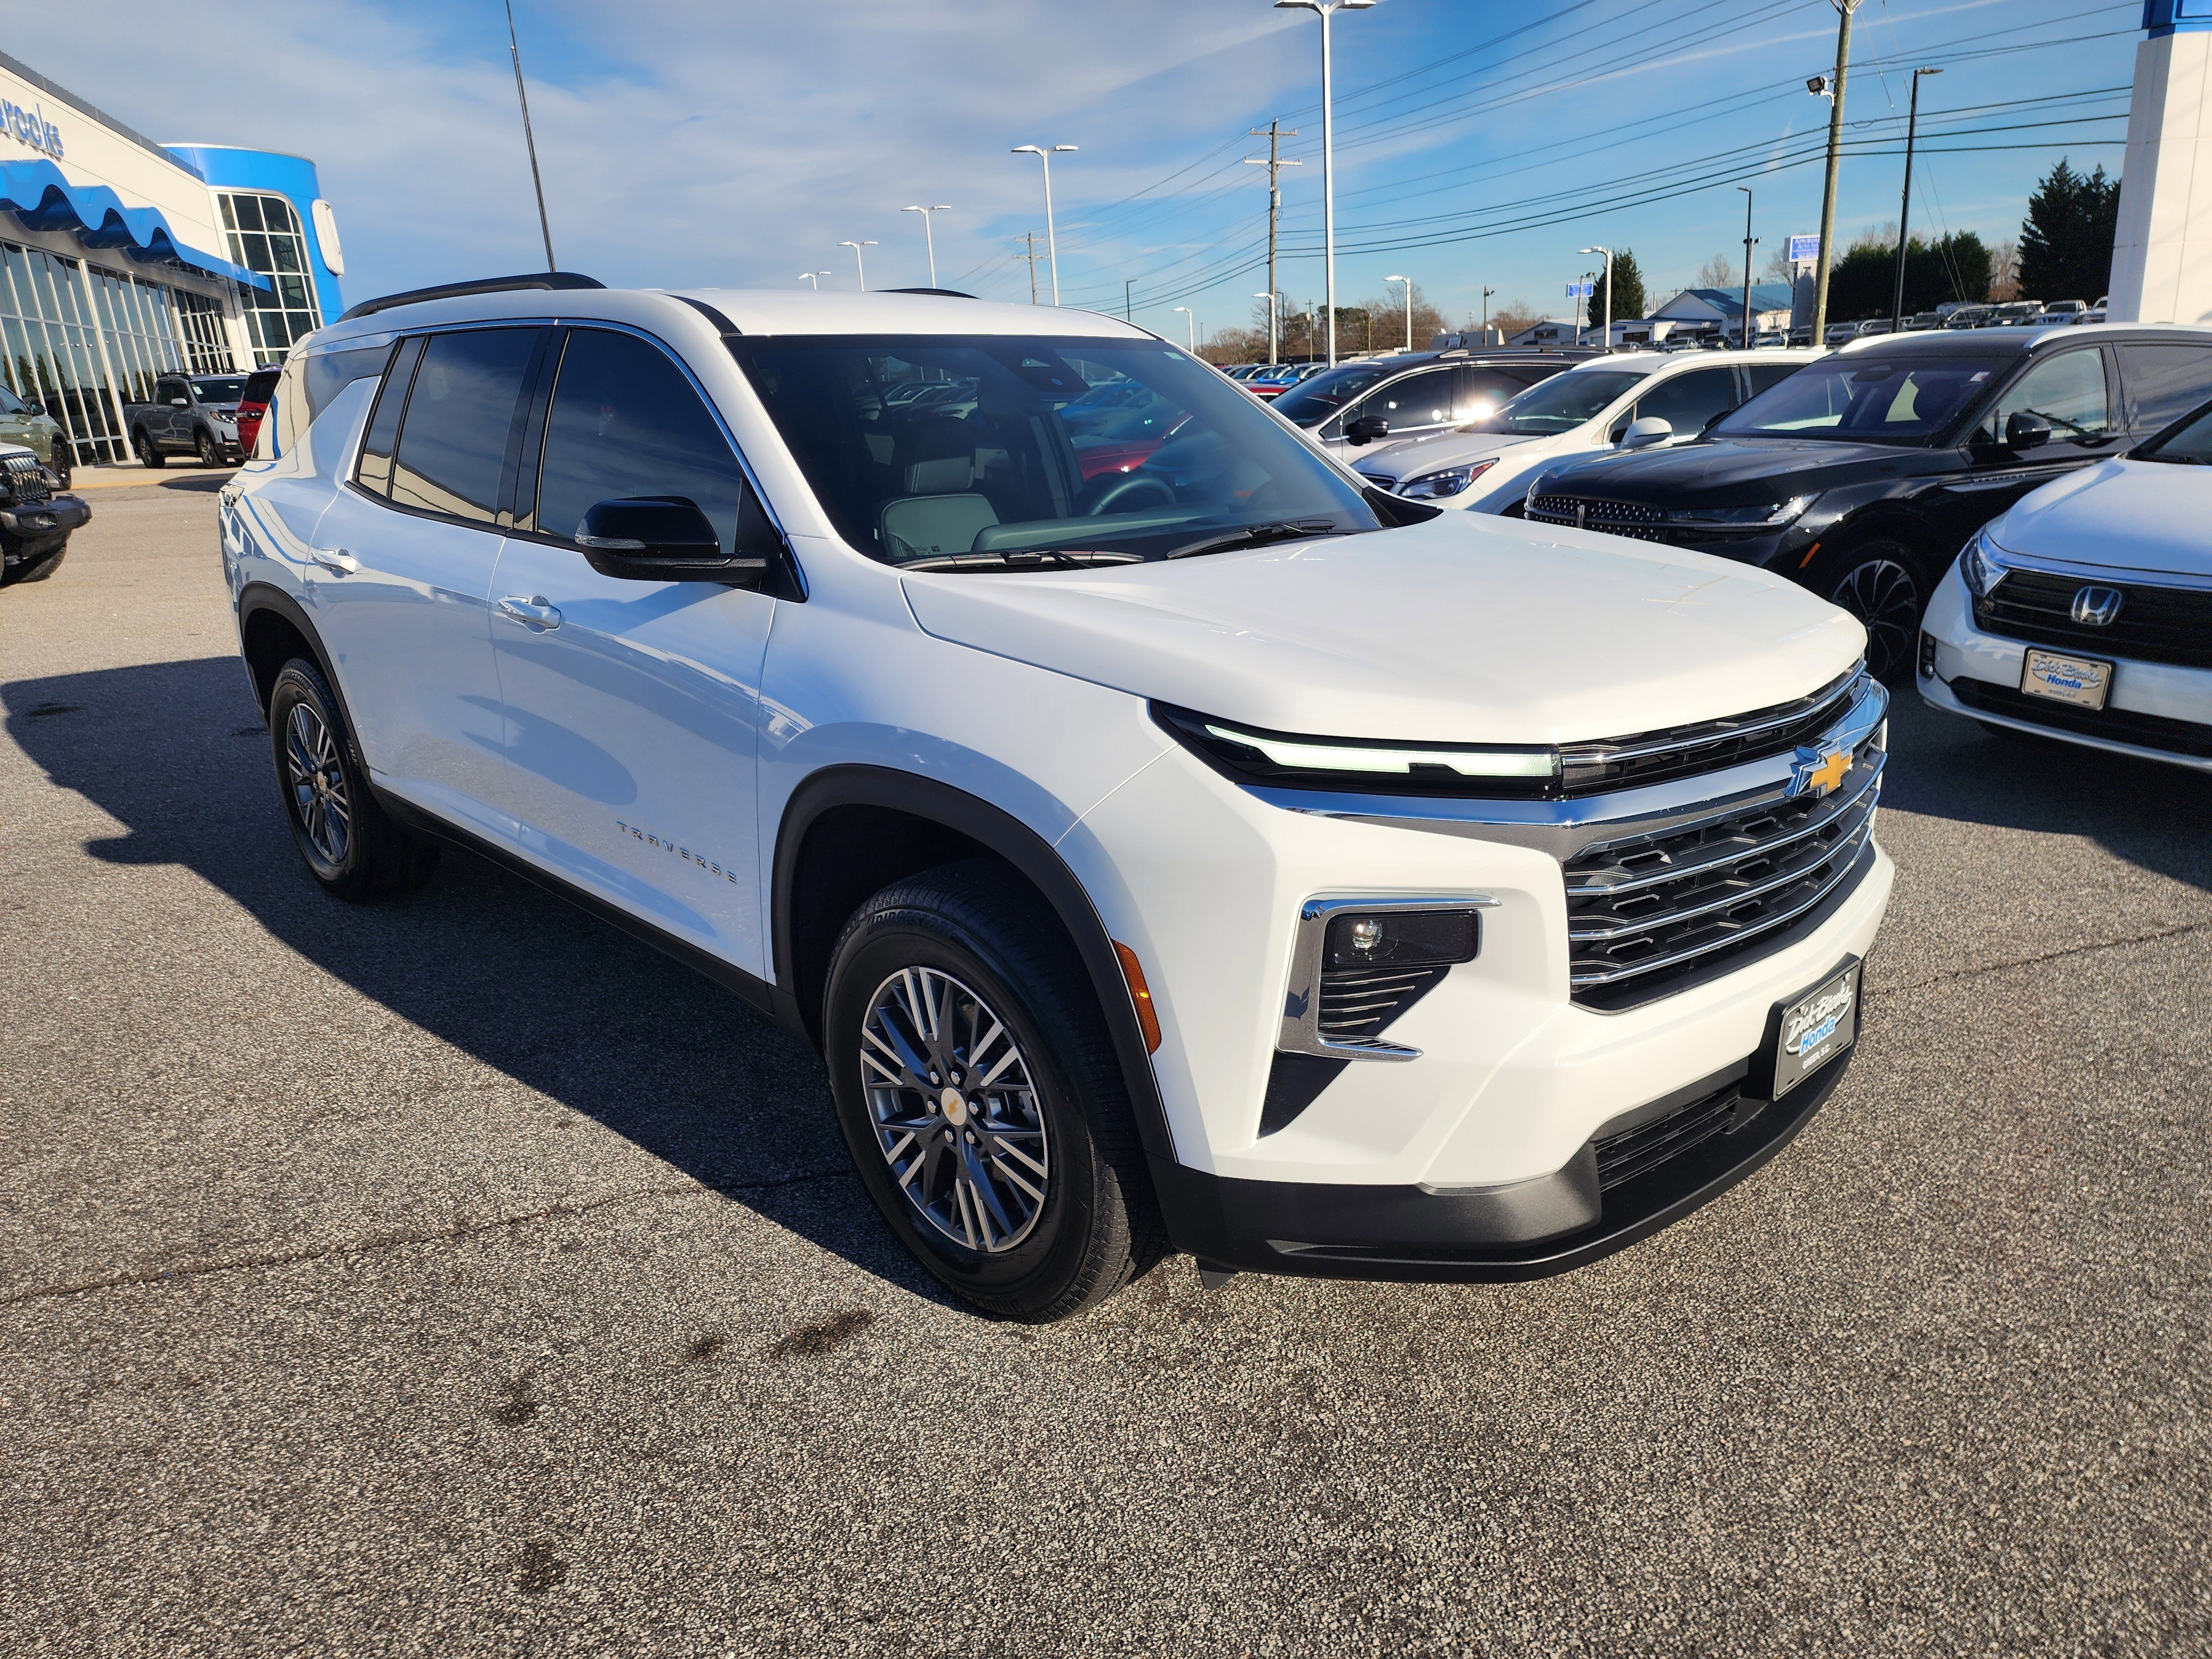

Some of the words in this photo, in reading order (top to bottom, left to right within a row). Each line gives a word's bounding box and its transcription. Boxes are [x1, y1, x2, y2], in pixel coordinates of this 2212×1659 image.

[2046, 674, 2081, 690] Honda
[616, 821, 737, 885] TRAVERSE
[1785, 1003, 1816, 1047] Dick
[1813, 981, 1854, 1022] Brooks
[1798, 1014, 1836, 1057] Honda
